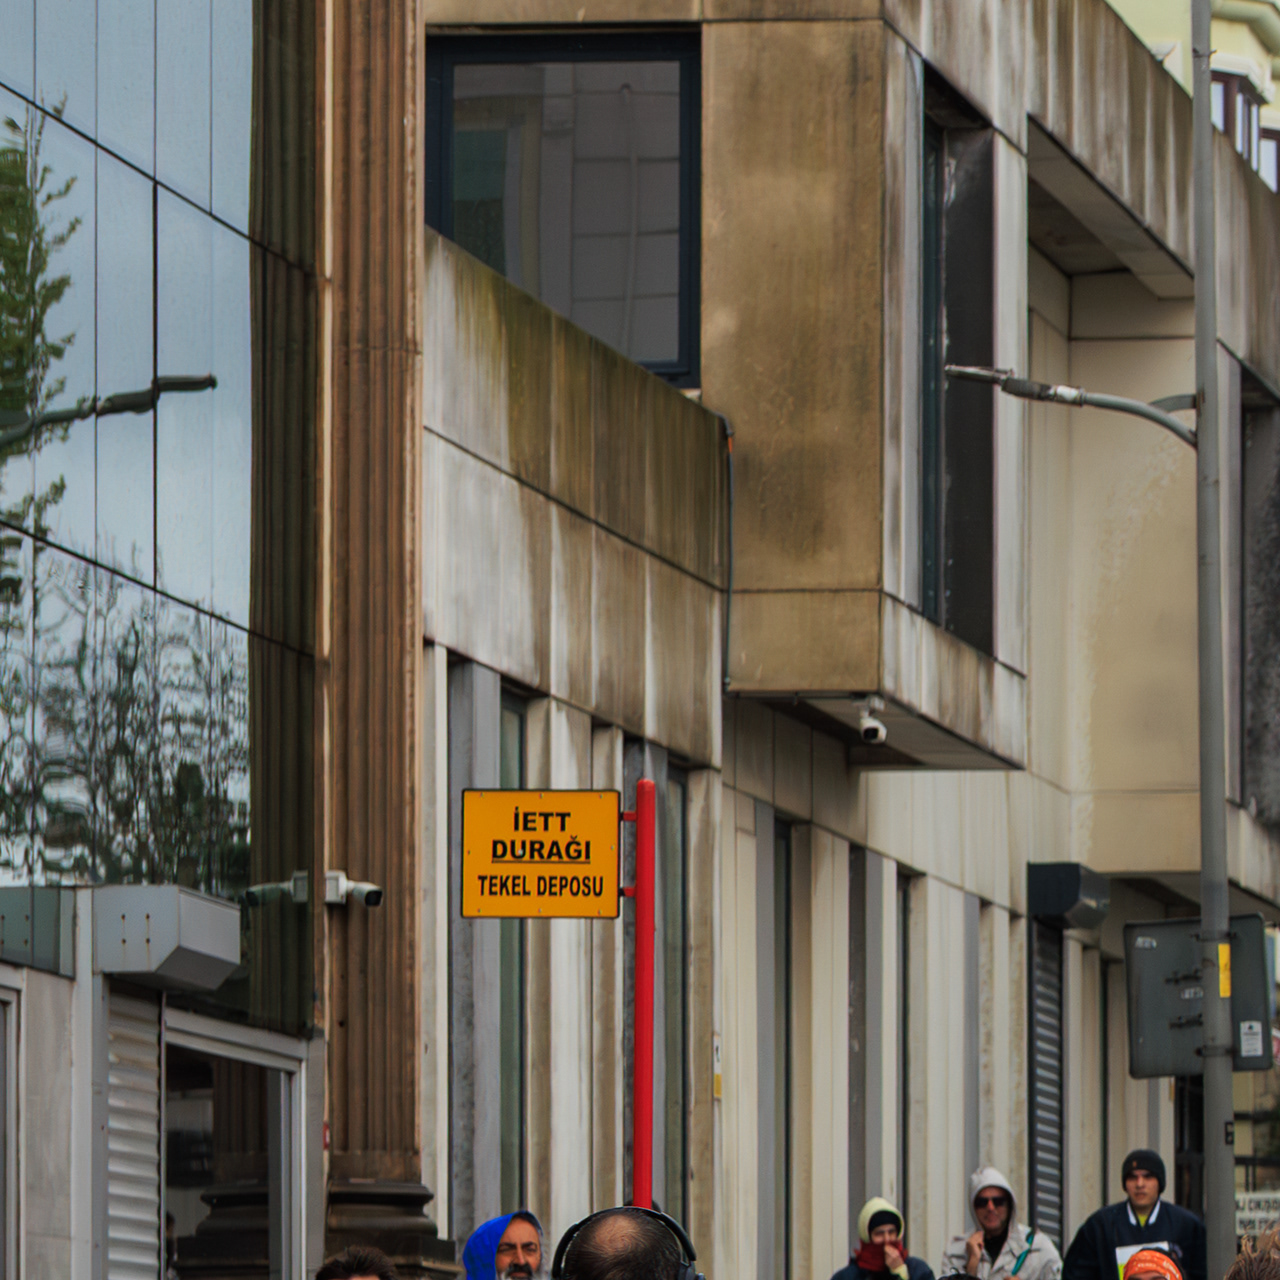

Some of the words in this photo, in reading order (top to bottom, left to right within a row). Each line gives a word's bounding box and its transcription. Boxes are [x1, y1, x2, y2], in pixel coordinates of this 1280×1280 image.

[513, 806, 571, 832] İETT
[491, 834, 592, 860] DURAĞI
[477, 875, 532, 897] TEKEL
[536, 876, 604, 897] DEPOSU
